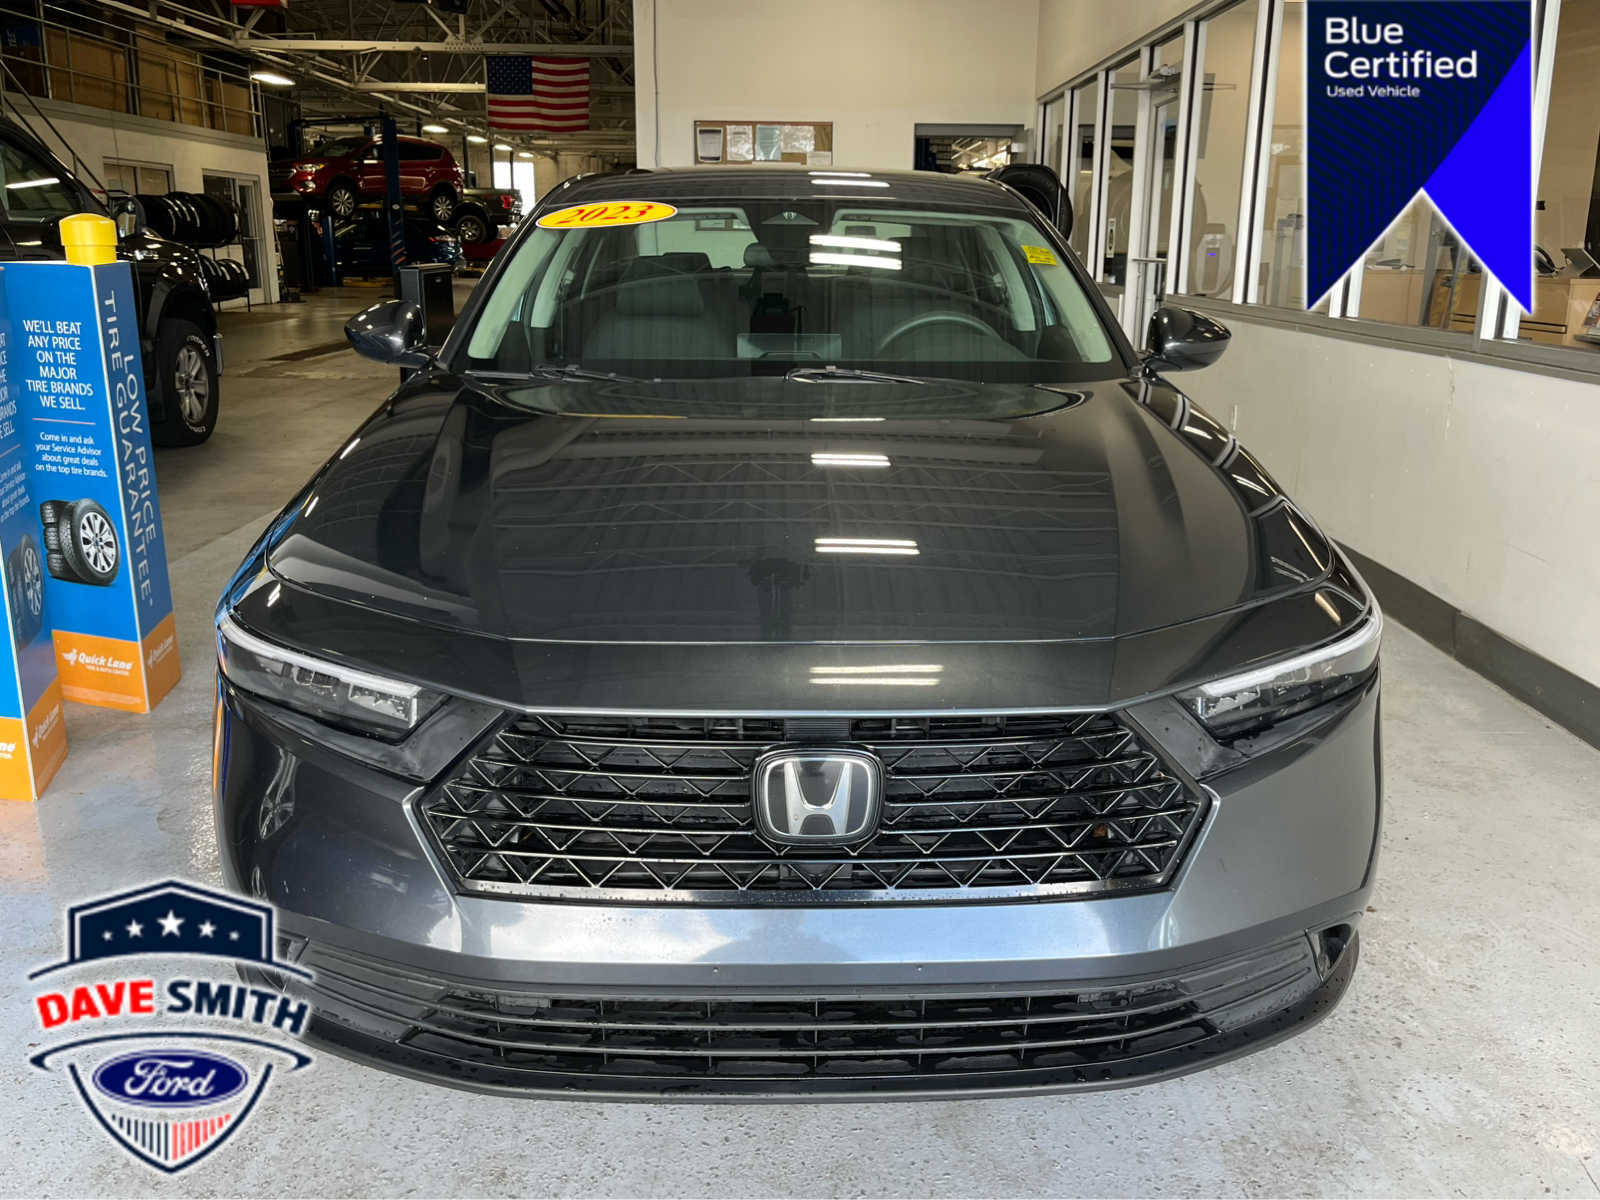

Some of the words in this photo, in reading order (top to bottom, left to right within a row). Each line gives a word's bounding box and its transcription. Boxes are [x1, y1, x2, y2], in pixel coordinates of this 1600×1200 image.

[552, 205, 655, 225] 2023
[23, 320, 55, 333] WE'LL
[56, 321, 82, 335] BEAT
[104, 289, 123, 372] TIRE
[28, 335, 49, 348] ANY
[52, 336, 82, 351] PRICE
[36, 351, 54, 363] ON
[55, 351, 77, 365] THE
[40, 366, 77, 380] MAJOR
[25, 380, 48, 393] TIRE
[50, 381, 94, 396] BRANDS
[40, 395, 58, 408] WE
[40, 432, 60, 442] Come
[69, 435, 82, 444] and
[83, 435, 95, 445] ask
[35, 443, 51, 453] your
[52, 443, 76, 454] Service
[77, 445, 102, 456] Advisor
[124, 354, 144, 434] LOW
[135, 446, 157, 544] PRICE
[42, 453, 62, 463] about
[63, 455, 80, 465] great
[81, 456, 99, 467] deals
[45, 463, 57, 473] the
[58, 465, 70, 475] top
[71, 466, 82, 475] tire
[78, 652, 107, 666] Quick
[106, 657, 134, 670] Lane
